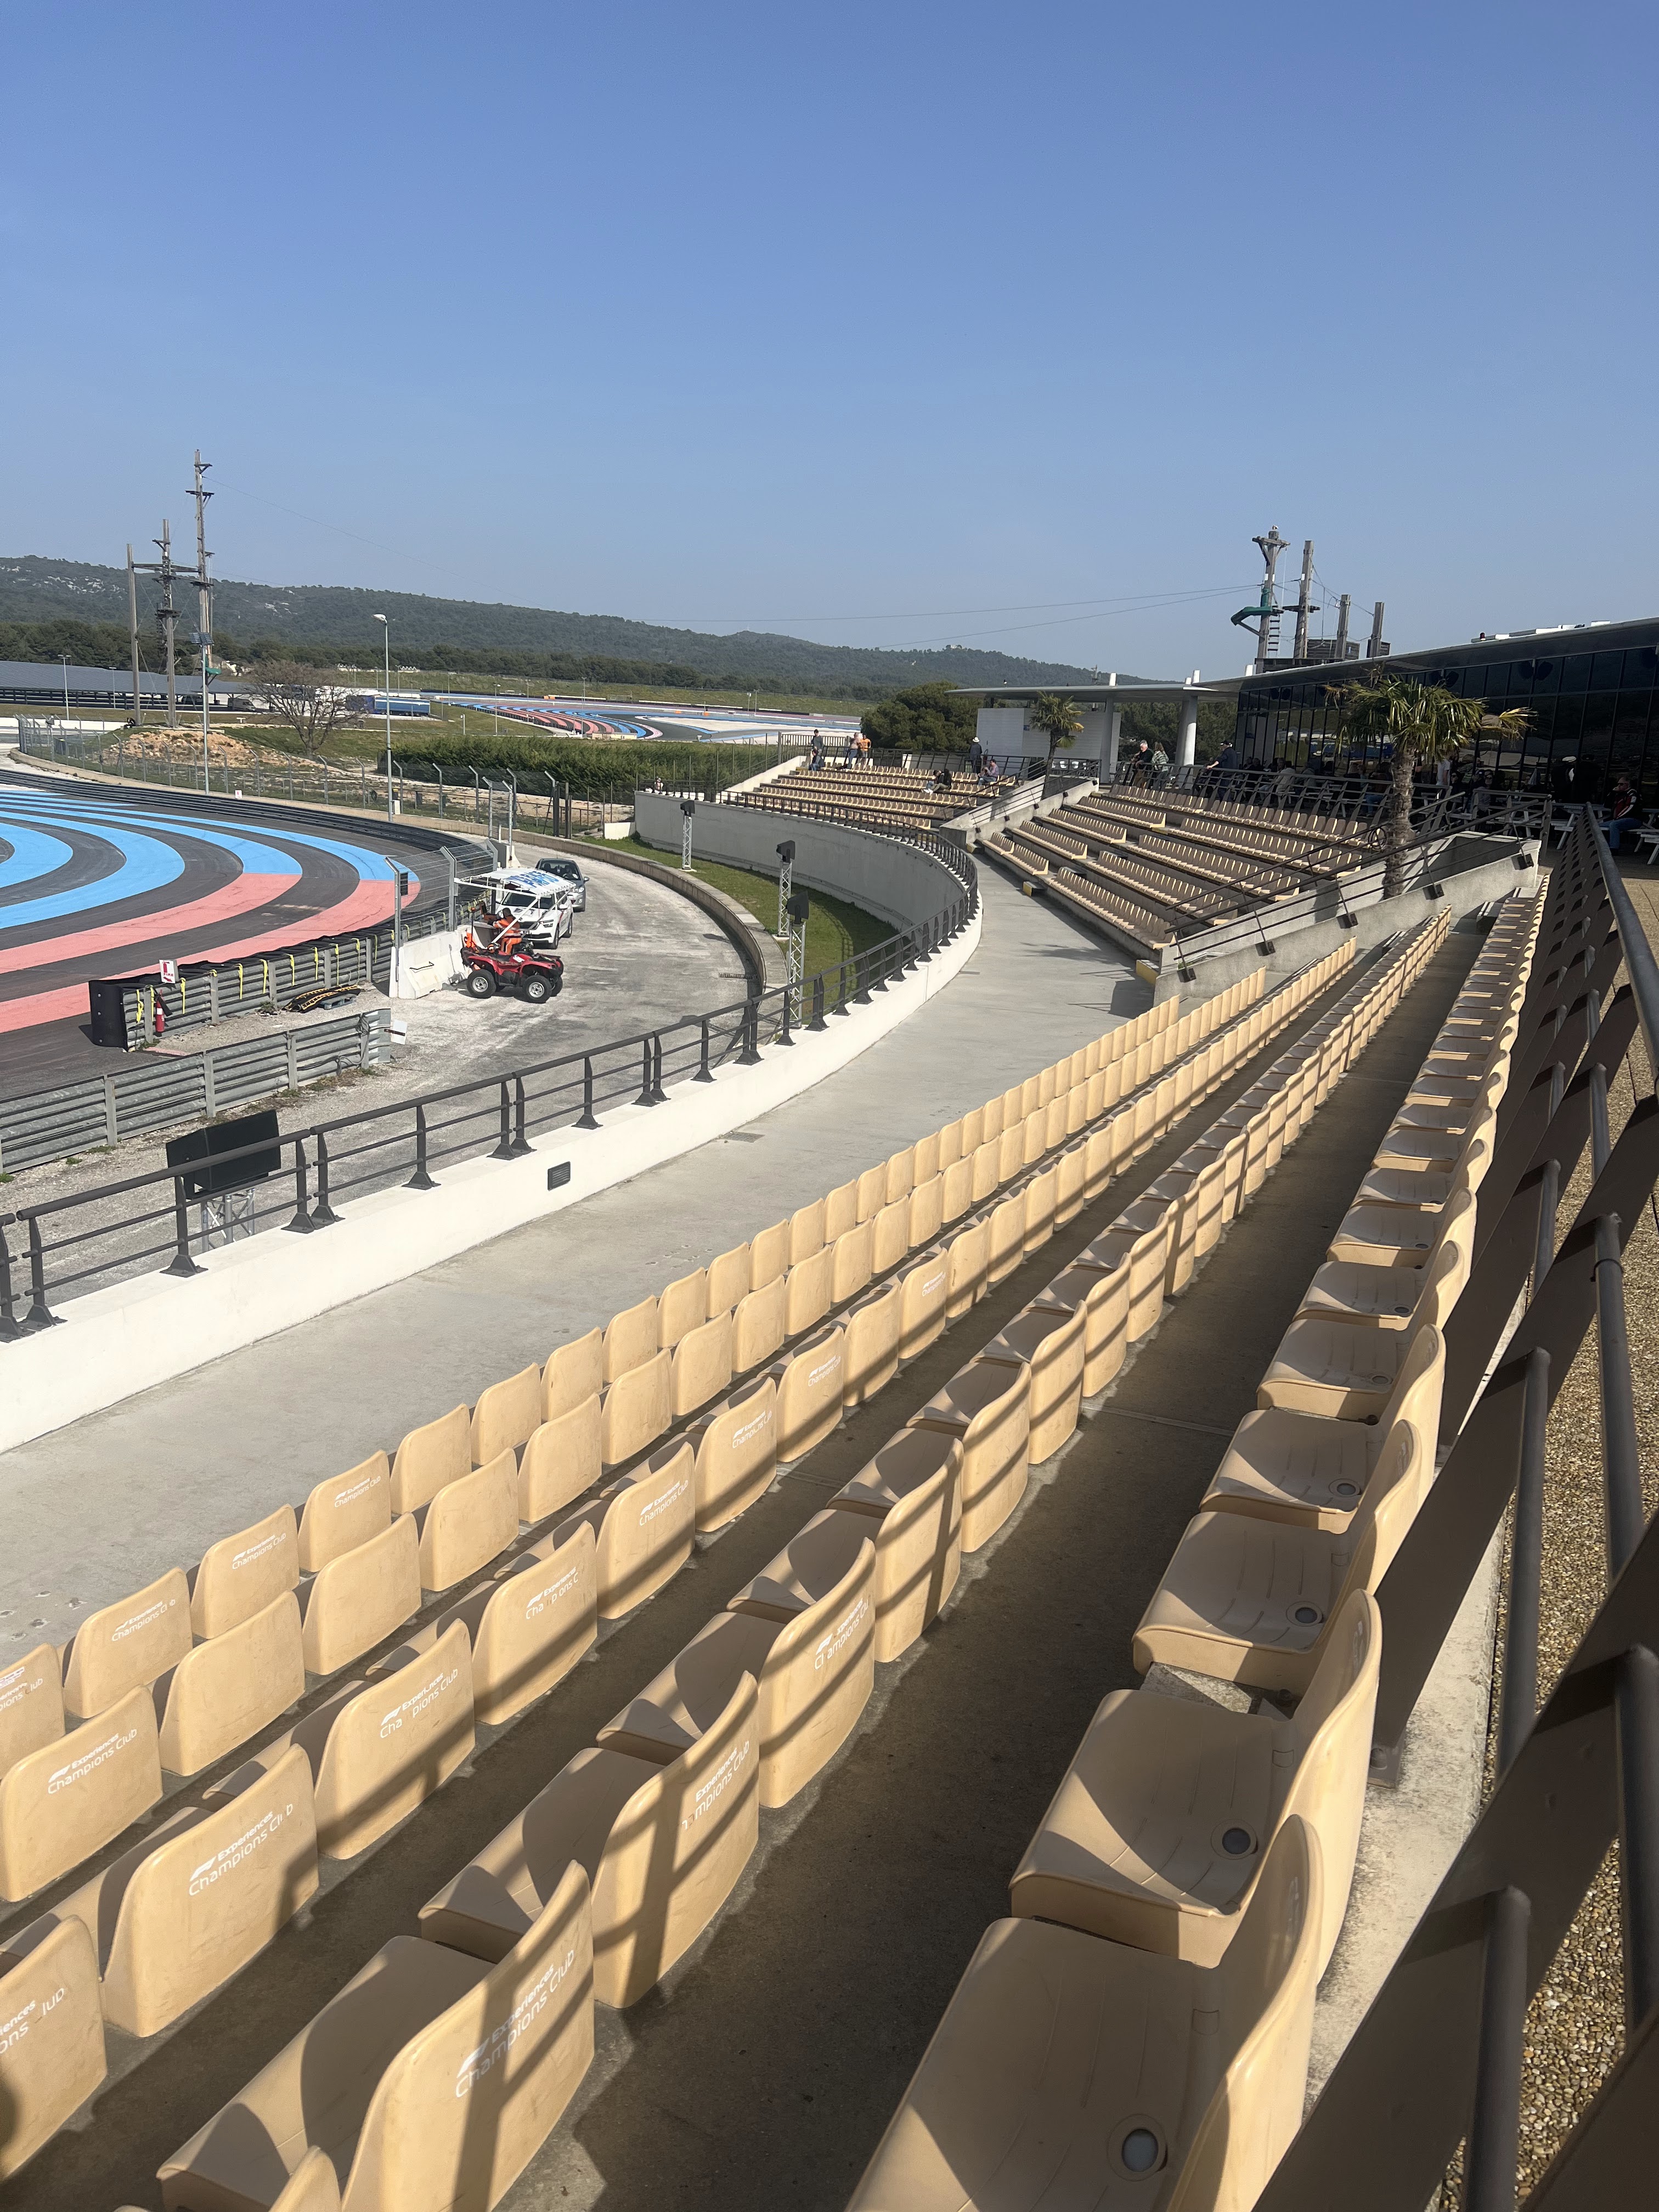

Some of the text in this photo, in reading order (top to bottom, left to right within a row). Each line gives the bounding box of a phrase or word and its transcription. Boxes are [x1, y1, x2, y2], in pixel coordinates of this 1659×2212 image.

[334, 1476, 381, 1508] Champions Club
[639, 1492, 678, 1526] Champions
[232, 1533, 286, 1570] Champions Club
[246, 1534, 275, 1554] Experiences
[526, 1579, 573, 1620] Chapons
[544, 1566, 577, 1596] Experiences
[111, 1599, 176, 1641] Champions Clb
[128, 1601, 163, 1624] Experiences
[836, 1598, 864, 1636] xperiences
[27, 1678, 43, 1693] lub
[380, 1668, 458, 1739] Chapions Club
[48, 1729, 137, 1794] Champions Club
[72, 1733, 119, 1769] Experiences
[734, 1741, 749, 1771] Club
[696, 1747, 737, 1802] Experiences
[218, 1811, 273, 1861] Experiences
[189, 1829, 268, 1896] Champions
[37, 1988, 65, 2020] lub
[492, 1965, 554, 2044] Experiences
[456, 1950, 574, 2097] Champions Club
